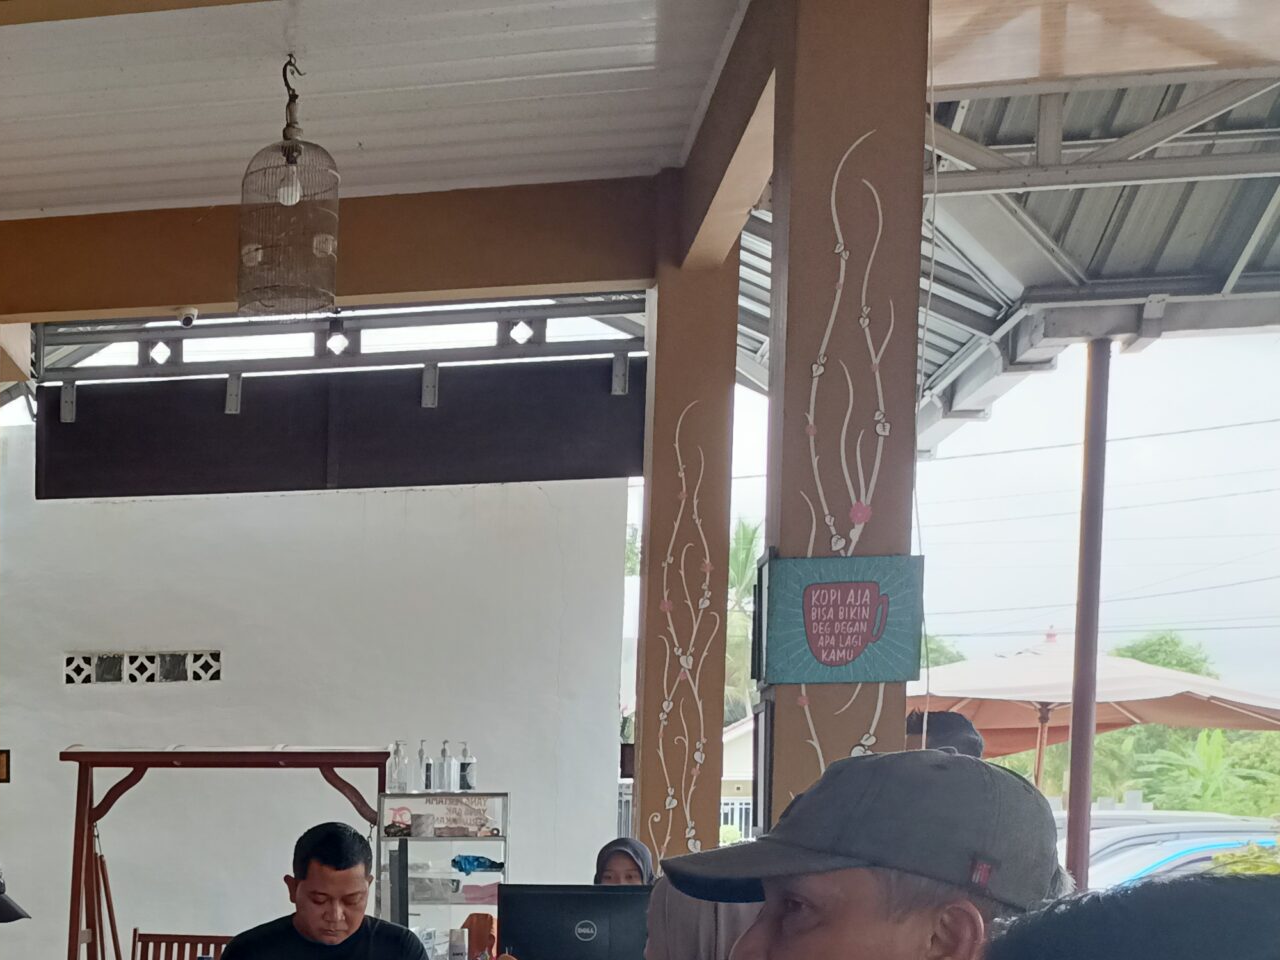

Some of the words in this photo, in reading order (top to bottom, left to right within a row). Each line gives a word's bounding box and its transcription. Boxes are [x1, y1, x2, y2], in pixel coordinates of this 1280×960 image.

[811, 589, 840, 605] KOPI
[846, 588, 870, 605] AJA
[811, 607, 834, 620] BISA
[838, 606, 869, 620] BIKIN
[812, 622, 830, 634] DEG
[834, 621, 867, 634] DEGAN
[818, 635, 835, 647] APA
[839, 635, 862, 647] LAGI
[821, 648, 853, 662] KAMU
